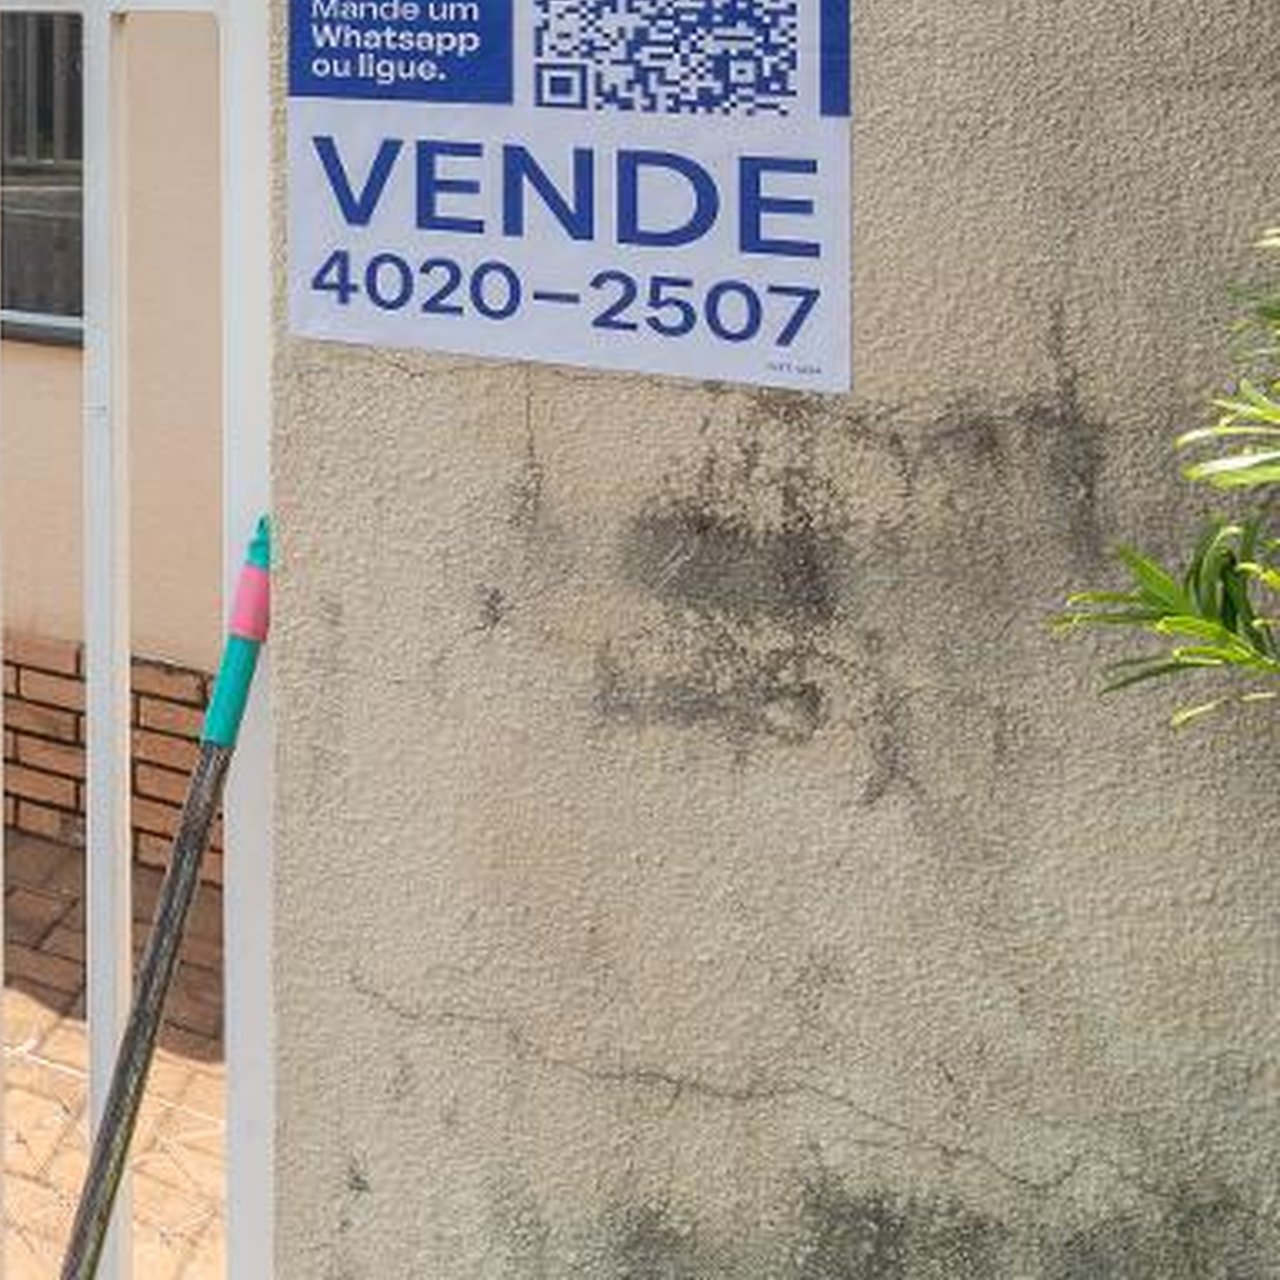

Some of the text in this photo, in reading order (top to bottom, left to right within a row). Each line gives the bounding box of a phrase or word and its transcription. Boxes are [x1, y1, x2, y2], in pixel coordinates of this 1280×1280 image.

[427, 0, 480, 21] um
[311, 23, 481, 58] Whatsapp
[311, 52, 446, 85] ou ligue.
[311, 135, 821, 258] VENDE
[310, 250, 821, 348] 4020-2507
